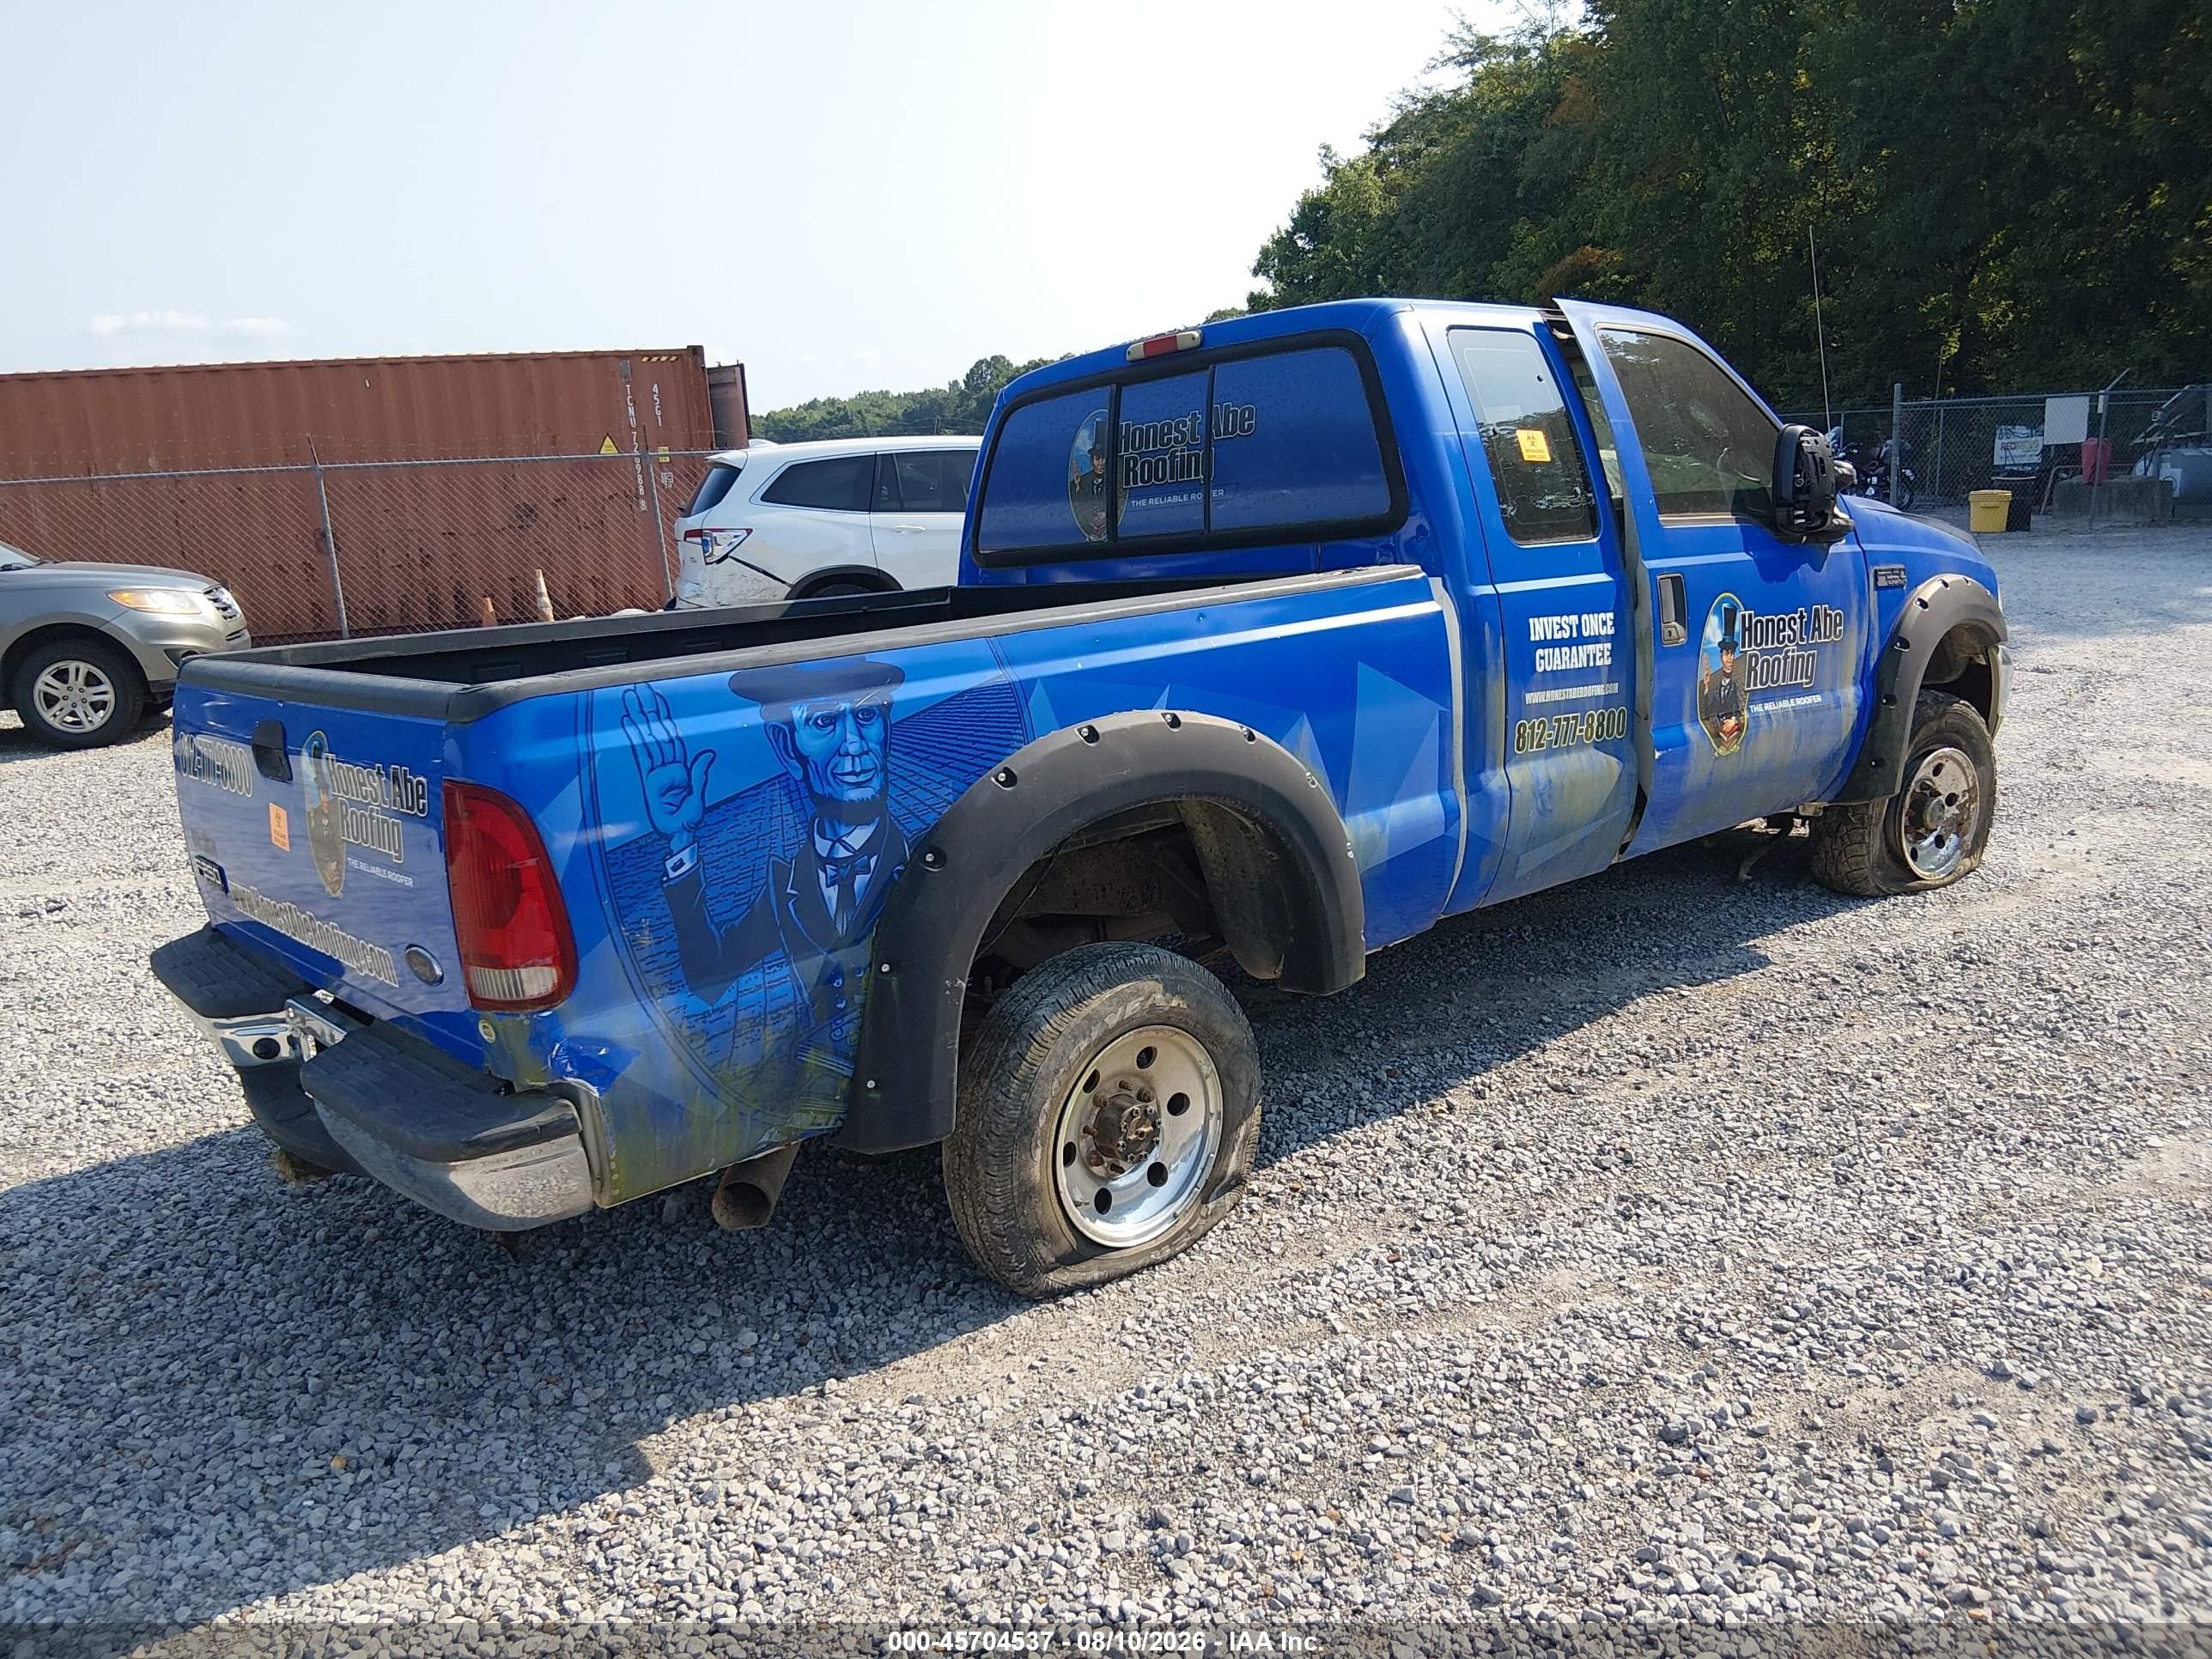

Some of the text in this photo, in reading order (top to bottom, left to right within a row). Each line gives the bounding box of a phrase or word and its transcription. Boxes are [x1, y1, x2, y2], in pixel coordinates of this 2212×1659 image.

[625, 385, 636, 428] TCNU
[653, 384, 662, 426] 45G1
[1118, 410, 1202, 455] Honest
[1131, 489, 1224, 507] THE RELIABLE ROER
[1528, 612, 1615, 641] INVEST ONCE
[1739, 605, 1844, 651] Honest Abe
[1535, 643, 1613, 673] GUARANTEE
[1745, 647, 1817, 690] Roofing
[1749, 694, 1822, 714] THE RELIABLE ROOFER
[1515, 707, 1628, 754] 812-777-8800
[179, 731, 252, 798] 812-777-8800
[325, 753, 428, 817] Honest Abe
[338, 798, 404, 864] Roofing
[347, 857, 413, 888] THE RELIABLE ROOFER
